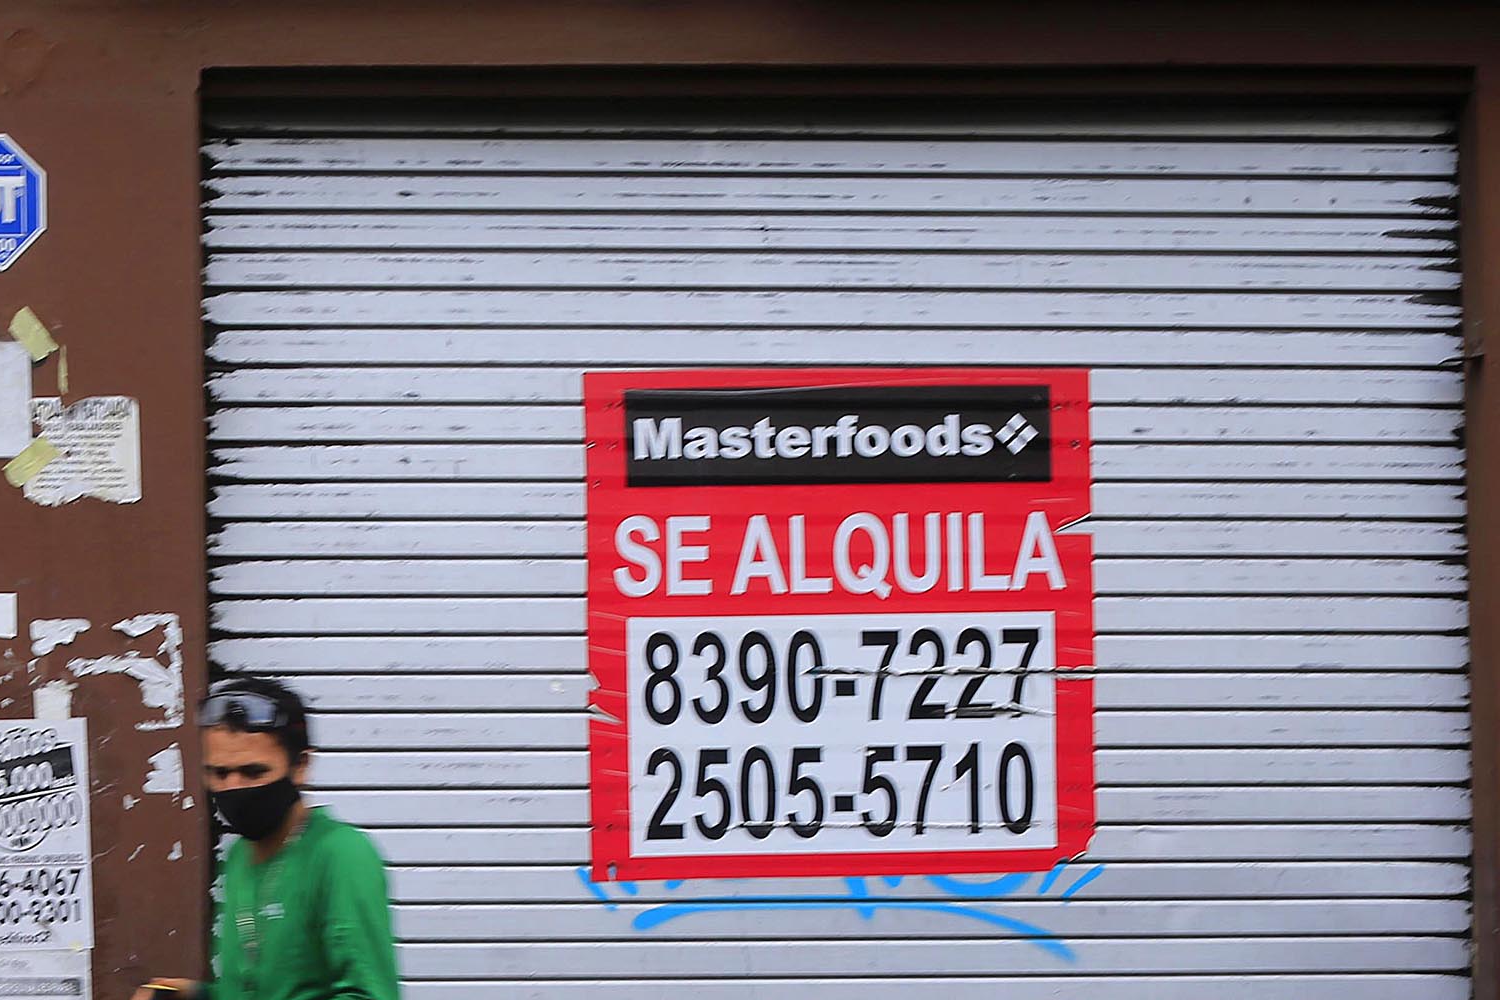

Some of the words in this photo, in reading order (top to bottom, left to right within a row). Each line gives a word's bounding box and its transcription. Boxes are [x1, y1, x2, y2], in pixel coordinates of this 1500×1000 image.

[633, 413, 995, 460] Masterfoods
[612, 514, 713, 598] SE
[730, 511, 1068, 600] ALQUILA
[644, 628, 1041, 725] 8390-7227
[644, 740, 1035, 841] 2505-5710
